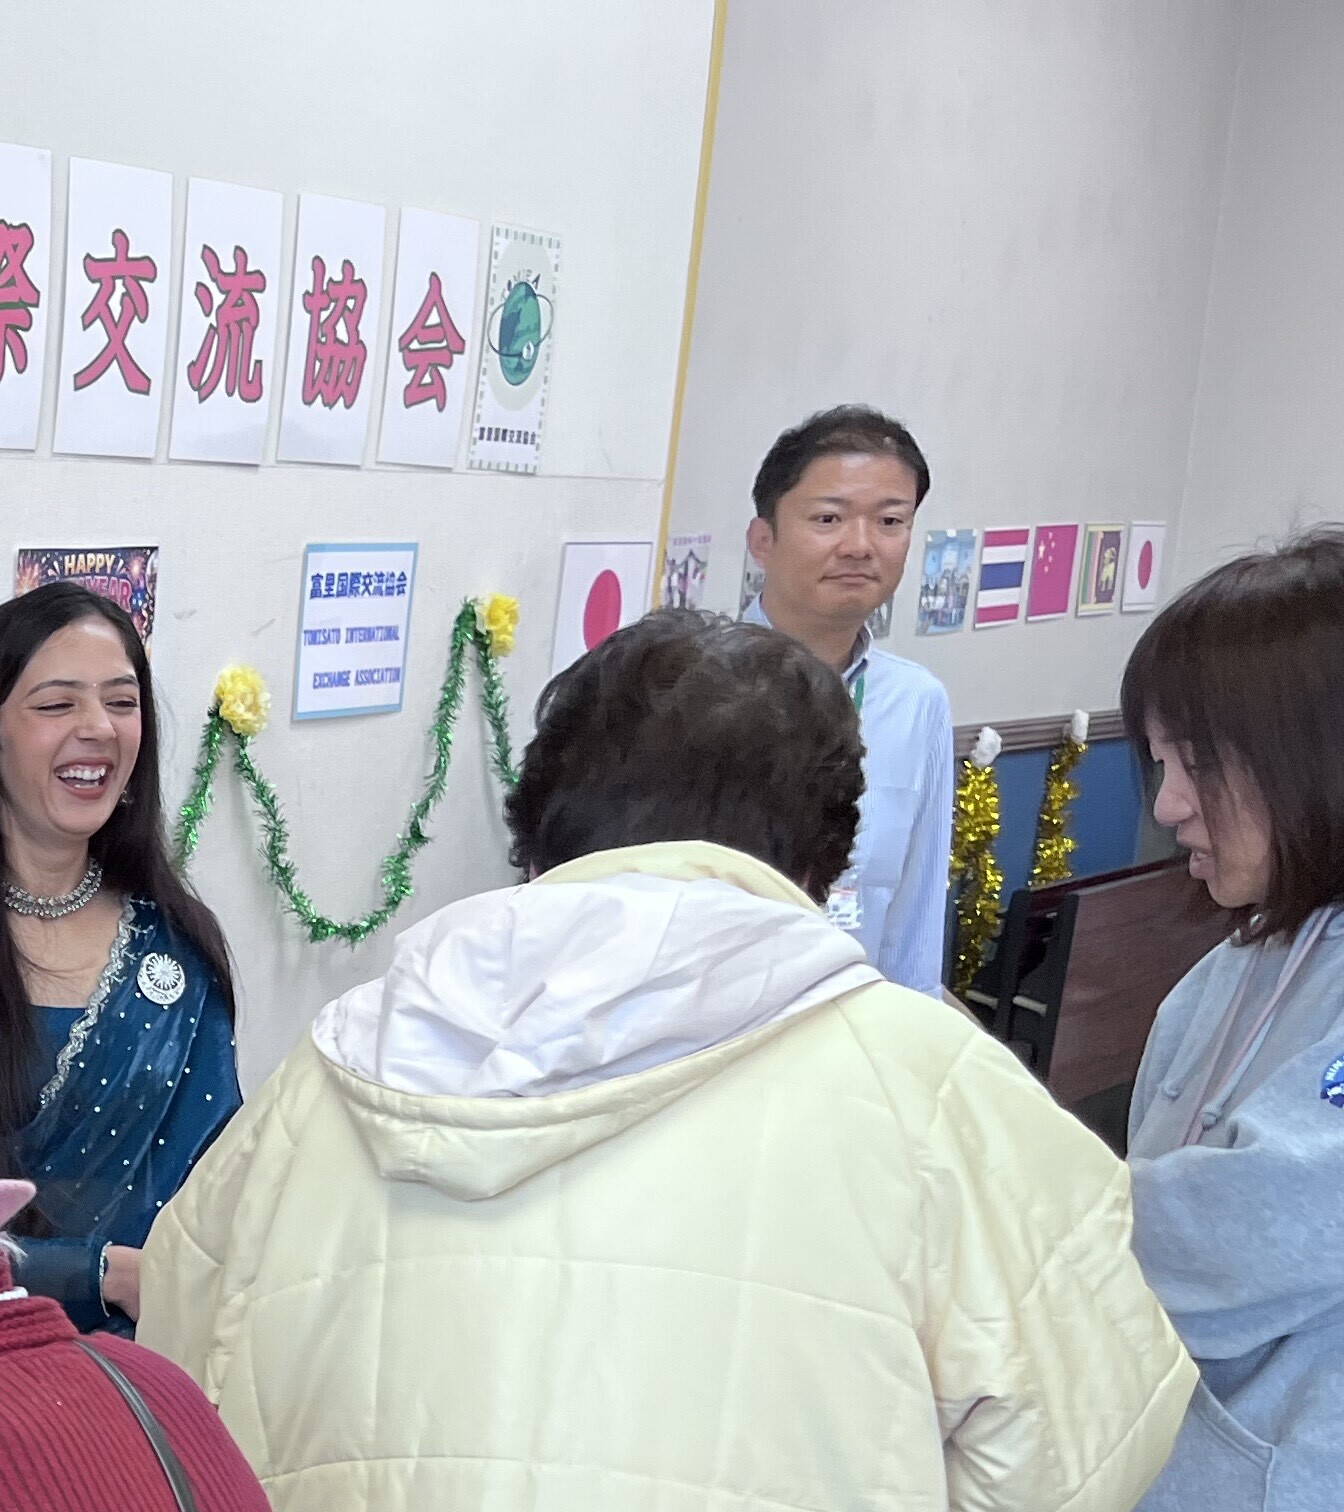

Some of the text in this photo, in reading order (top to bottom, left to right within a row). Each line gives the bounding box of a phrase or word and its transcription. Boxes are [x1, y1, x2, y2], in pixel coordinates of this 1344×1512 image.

[64, 553, 116, 576] HAPPY
[310, 571, 407, 599] 富里国際交流協会
